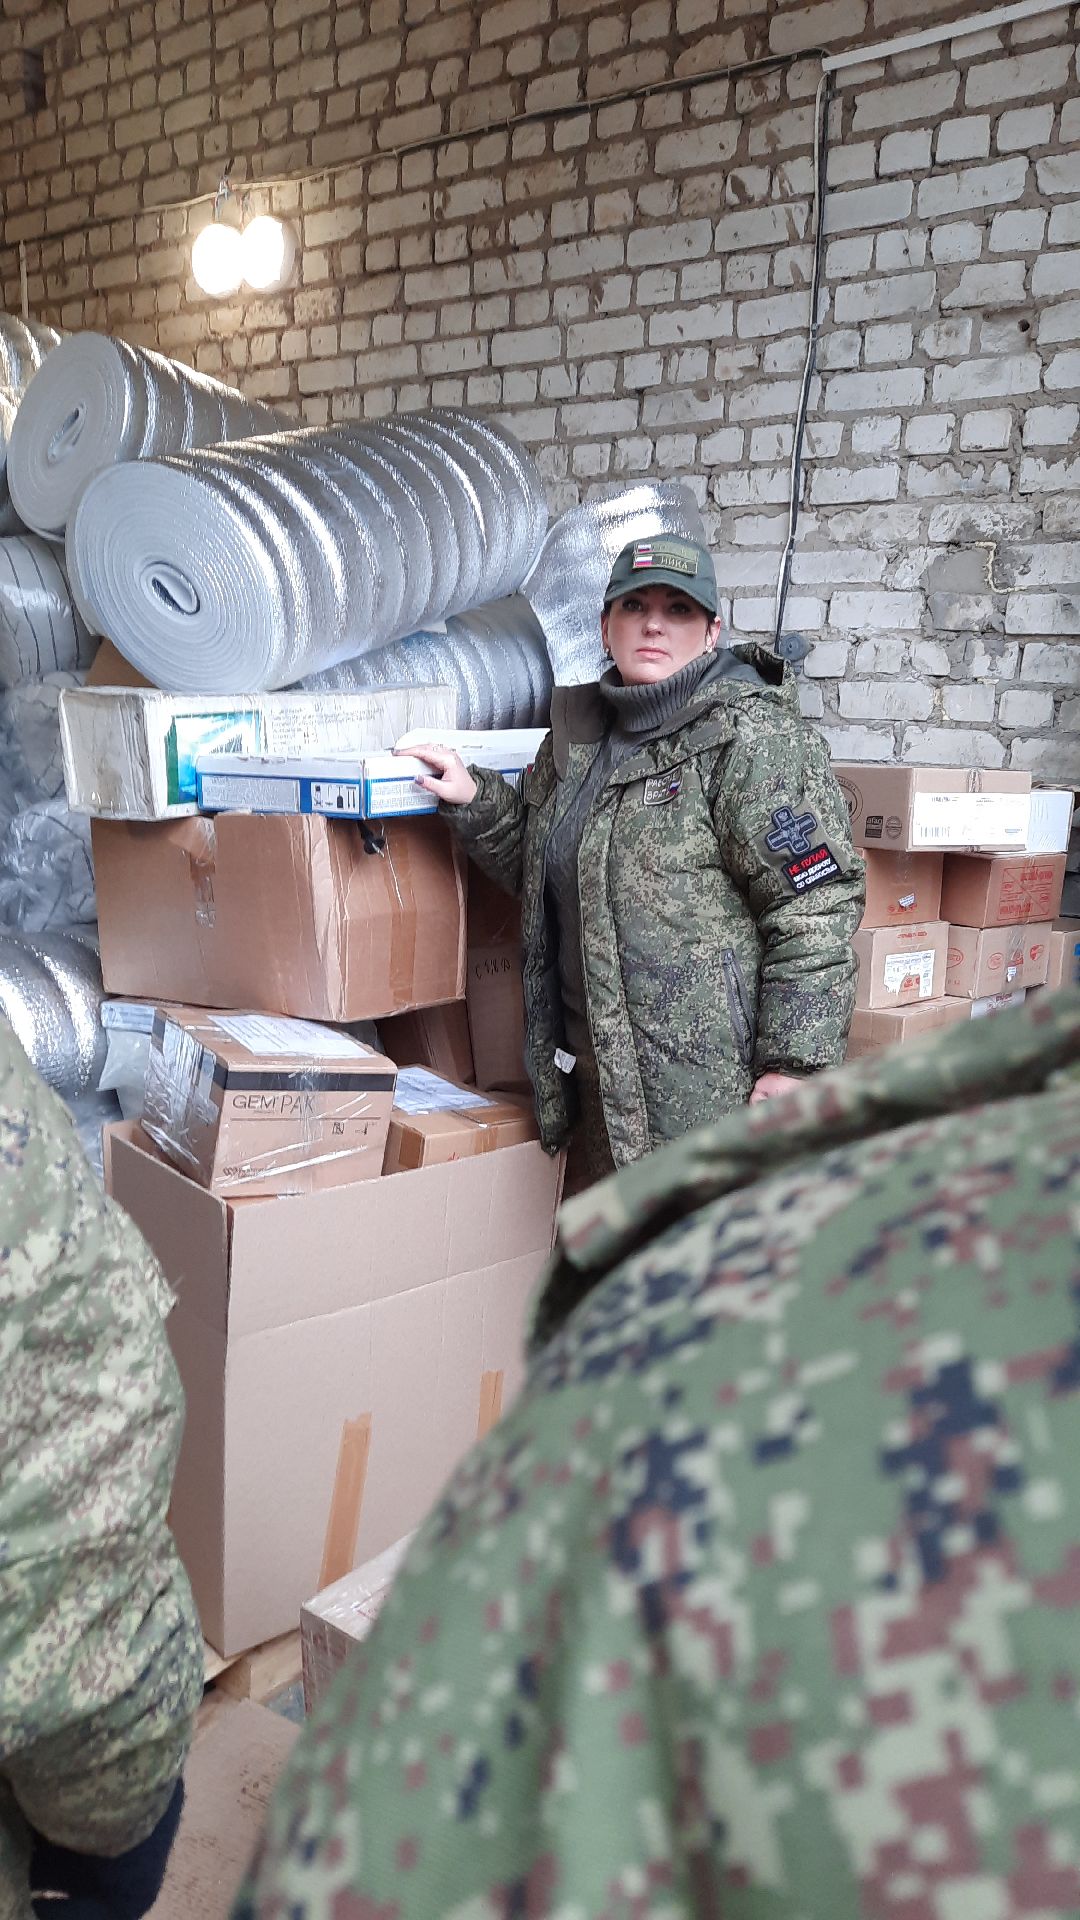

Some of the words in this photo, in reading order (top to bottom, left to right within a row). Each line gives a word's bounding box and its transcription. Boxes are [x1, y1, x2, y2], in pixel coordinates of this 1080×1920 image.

[788, 863, 801, 876] НЕ
[800, 849, 827, 869] ПУТАЙ
[232, 1094, 276, 1109] GEM
[280, 1094, 316, 1114] PAK
